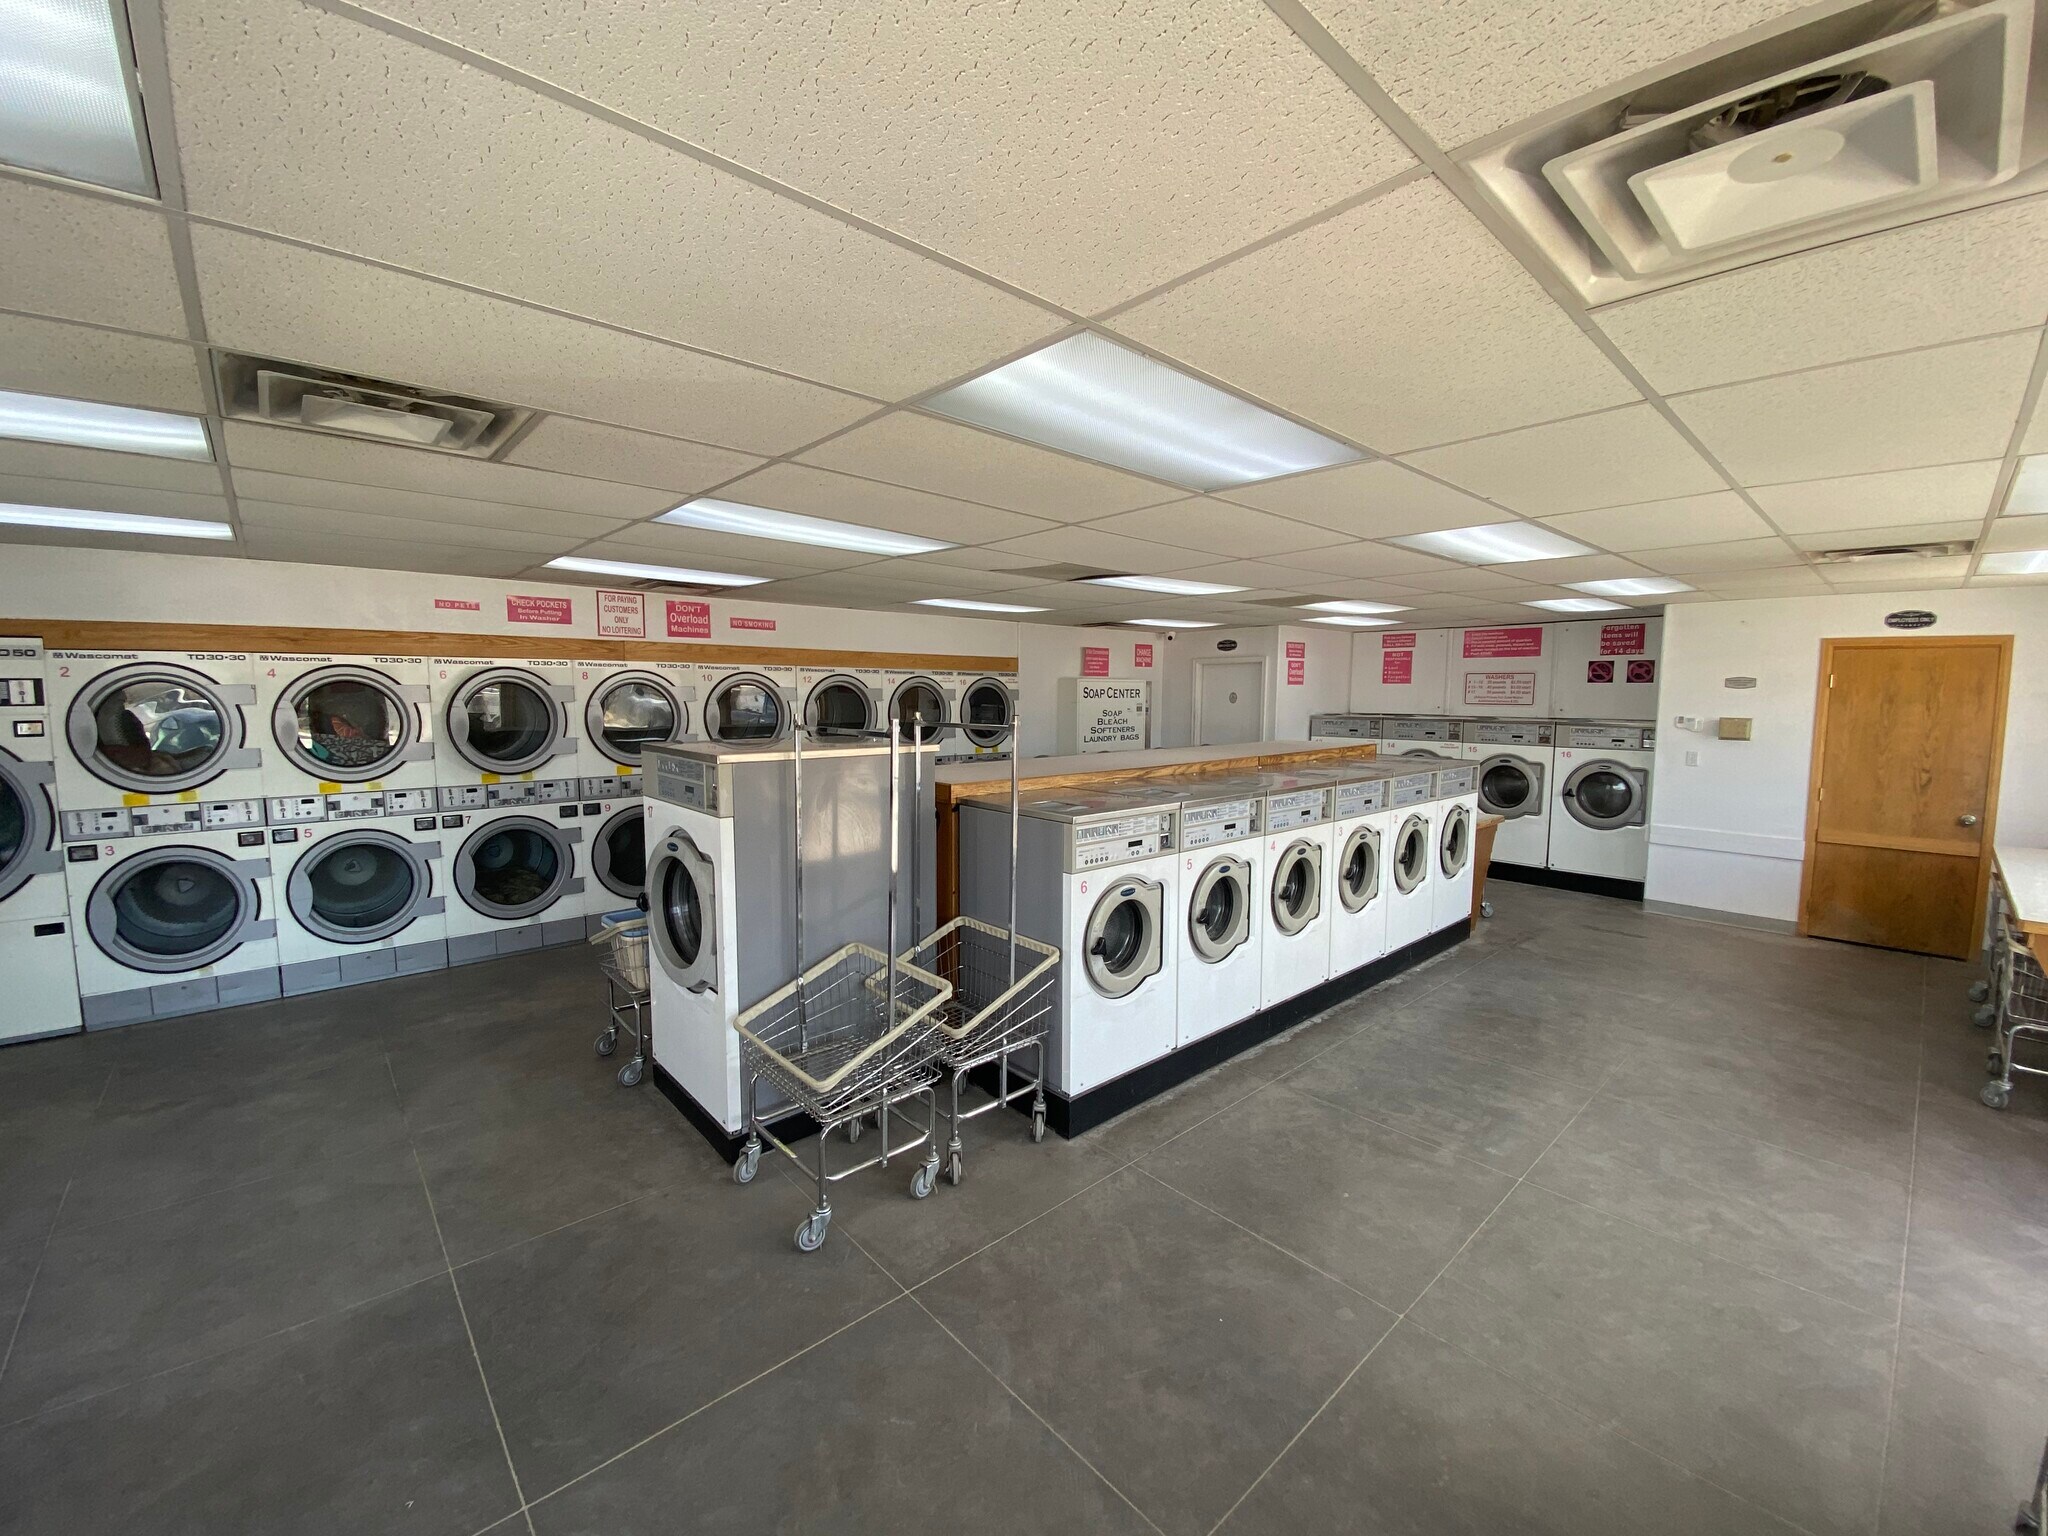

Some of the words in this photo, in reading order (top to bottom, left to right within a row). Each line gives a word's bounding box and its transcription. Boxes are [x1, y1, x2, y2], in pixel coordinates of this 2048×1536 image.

[536, 600, 567, 608] POCKETS
[617, 596, 637, 604] PAYING
[604, 605, 638, 614] CUSTOMERS
[670, 612, 708, 624] Overload
[612, 626, 641, 634] LOITERING
[671, 625, 708, 633] Machines
[1136, 648, 1152, 656] CHANGE
[60, 666, 70, 678] 2
[267, 668, 276, 678] 4
[440, 670, 446, 679] 6
[1083, 687, 1106, 698] SOAP
[1106, 687, 1141, 698] CENTER
[1090, 726, 1136, 734] SOFTENERS
[1084, 735, 1117, 743] LAUNDRY
[604, 804, 611, 812] 9
[465, 816, 471, 824] 7
[1394, 815, 1398, 824] 2
[304, 829, 312, 838] 5
[1339, 827, 1343, 836] 3
[1270, 841, 1276, 851] 4
[105, 846, 115, 856] 3
[1187, 859, 1193, 870] 5
[1080, 881, 1088, 894] 6
